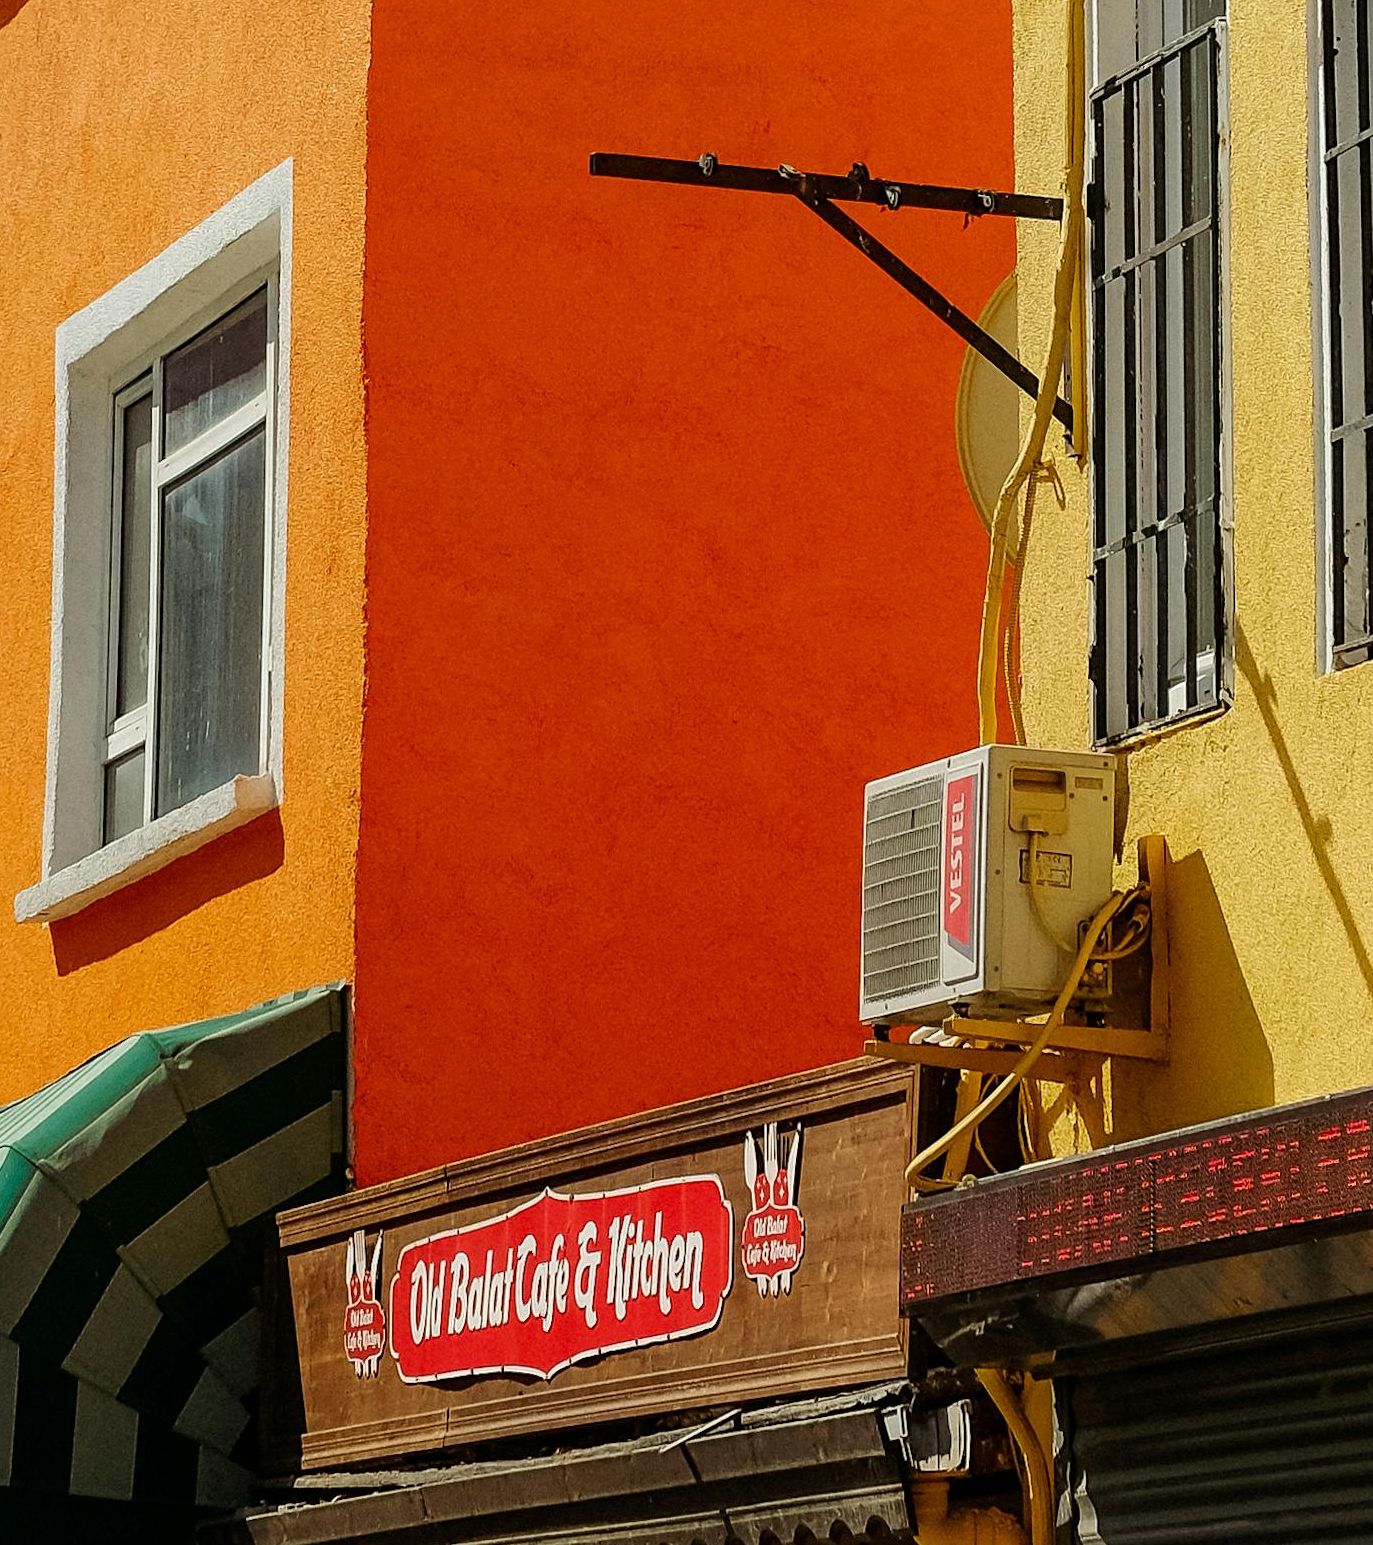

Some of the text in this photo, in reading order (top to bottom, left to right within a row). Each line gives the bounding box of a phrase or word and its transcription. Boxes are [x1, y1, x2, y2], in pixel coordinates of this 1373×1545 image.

[949, 792, 965, 915] VESTEL
[409, 1259, 446, 1345] Old
[447, 1247, 514, 1335] Balat
[573, 1220, 602, 1329] &
[606, 1210, 705, 1321] Kitchen
[753, 1214, 788, 1238] Old Balat
